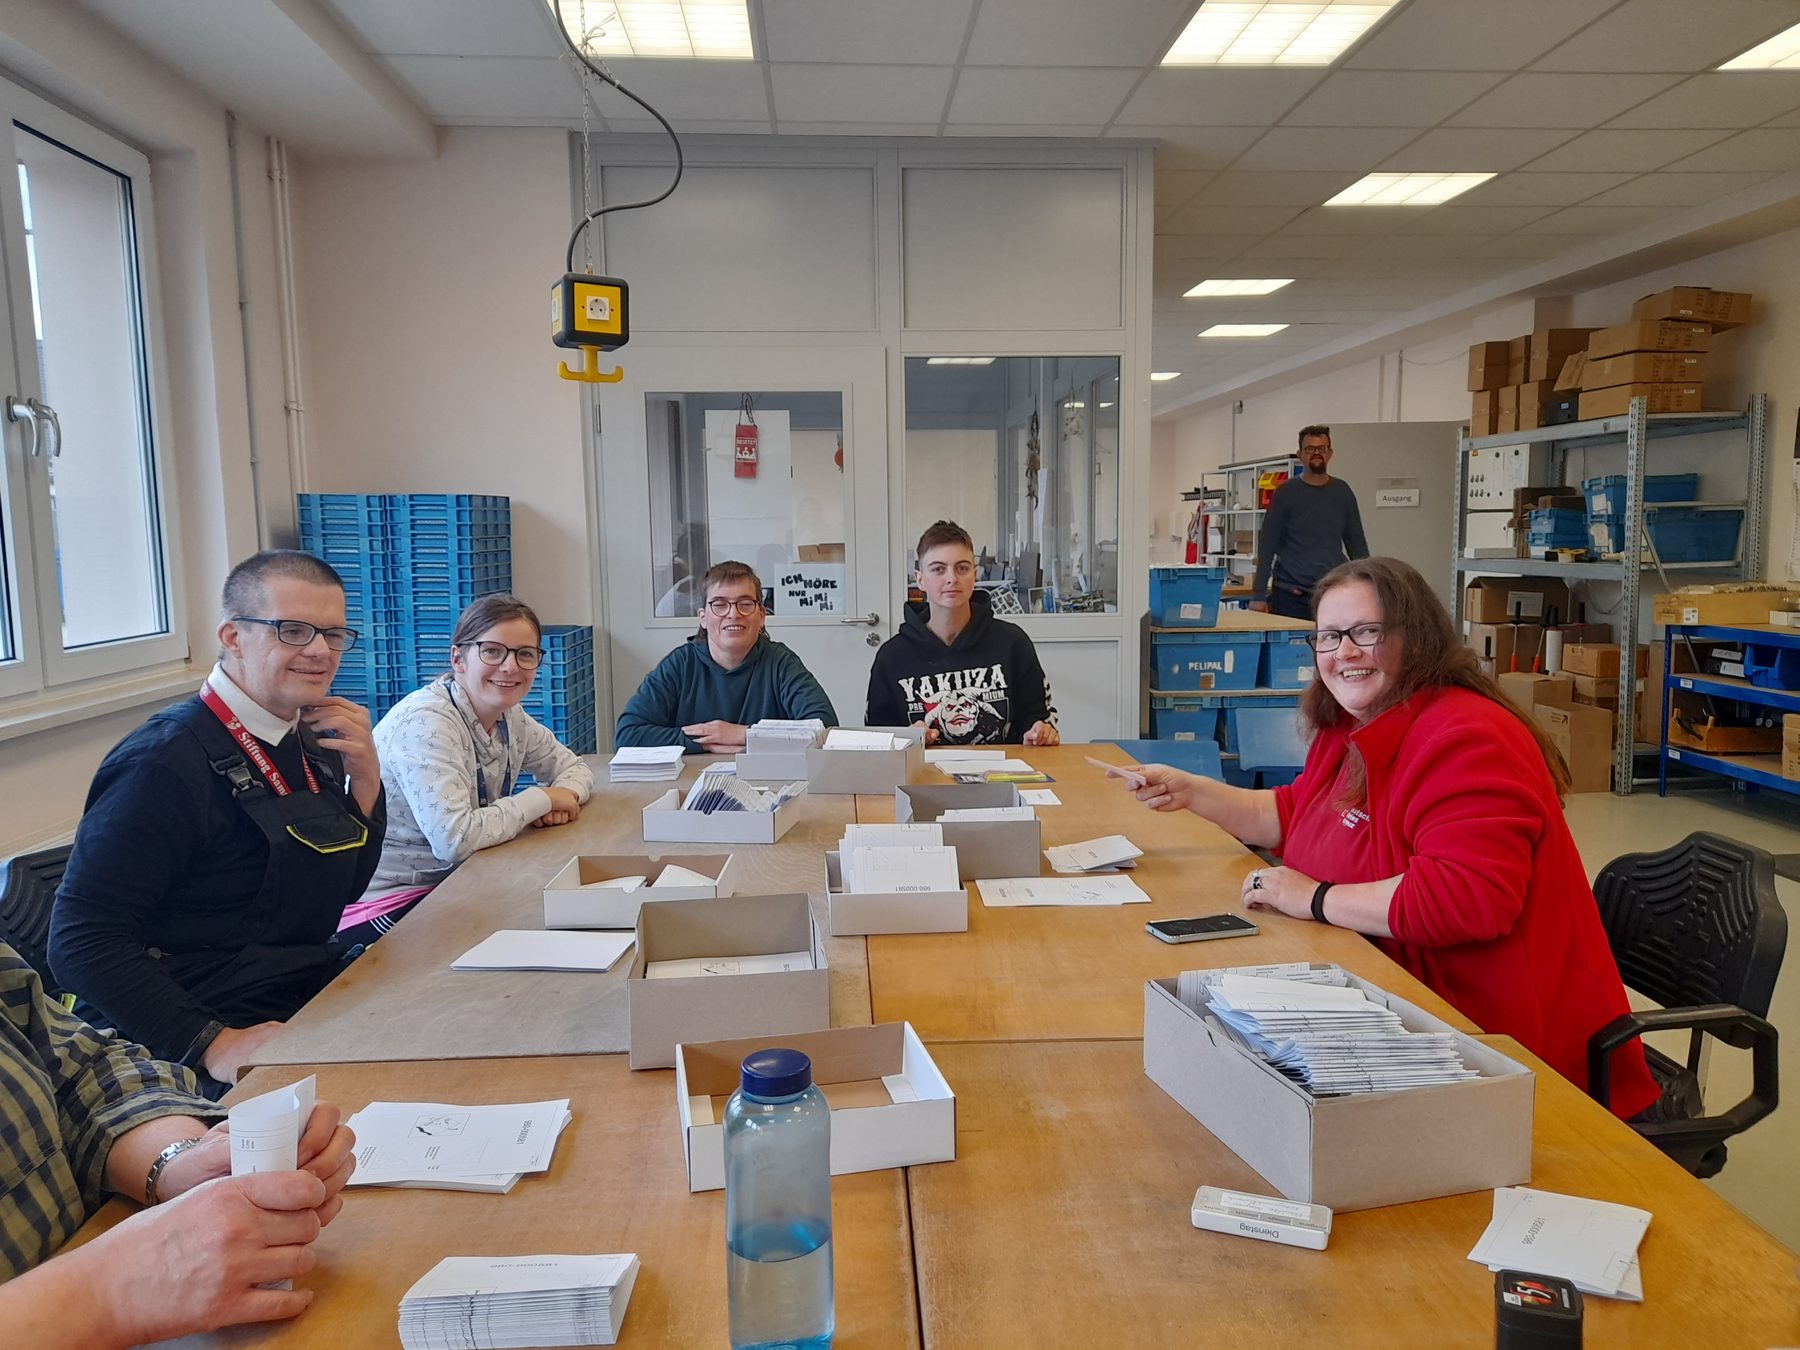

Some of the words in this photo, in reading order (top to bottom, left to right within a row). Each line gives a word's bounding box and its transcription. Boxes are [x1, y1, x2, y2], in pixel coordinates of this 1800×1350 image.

[1382, 495, 1412, 503] Ausgang
[781, 573, 804, 587] ICH
[803, 577, 838, 589] HÖRE
[1188, 661, 1223, 671] PELIPAL
[898, 664, 1008, 702] YAKUZA
[982, 690, 1005, 700] MIUM
[238, 731, 271, 774] Stiftung
[1239, 1222, 1280, 1239] Dienstag
